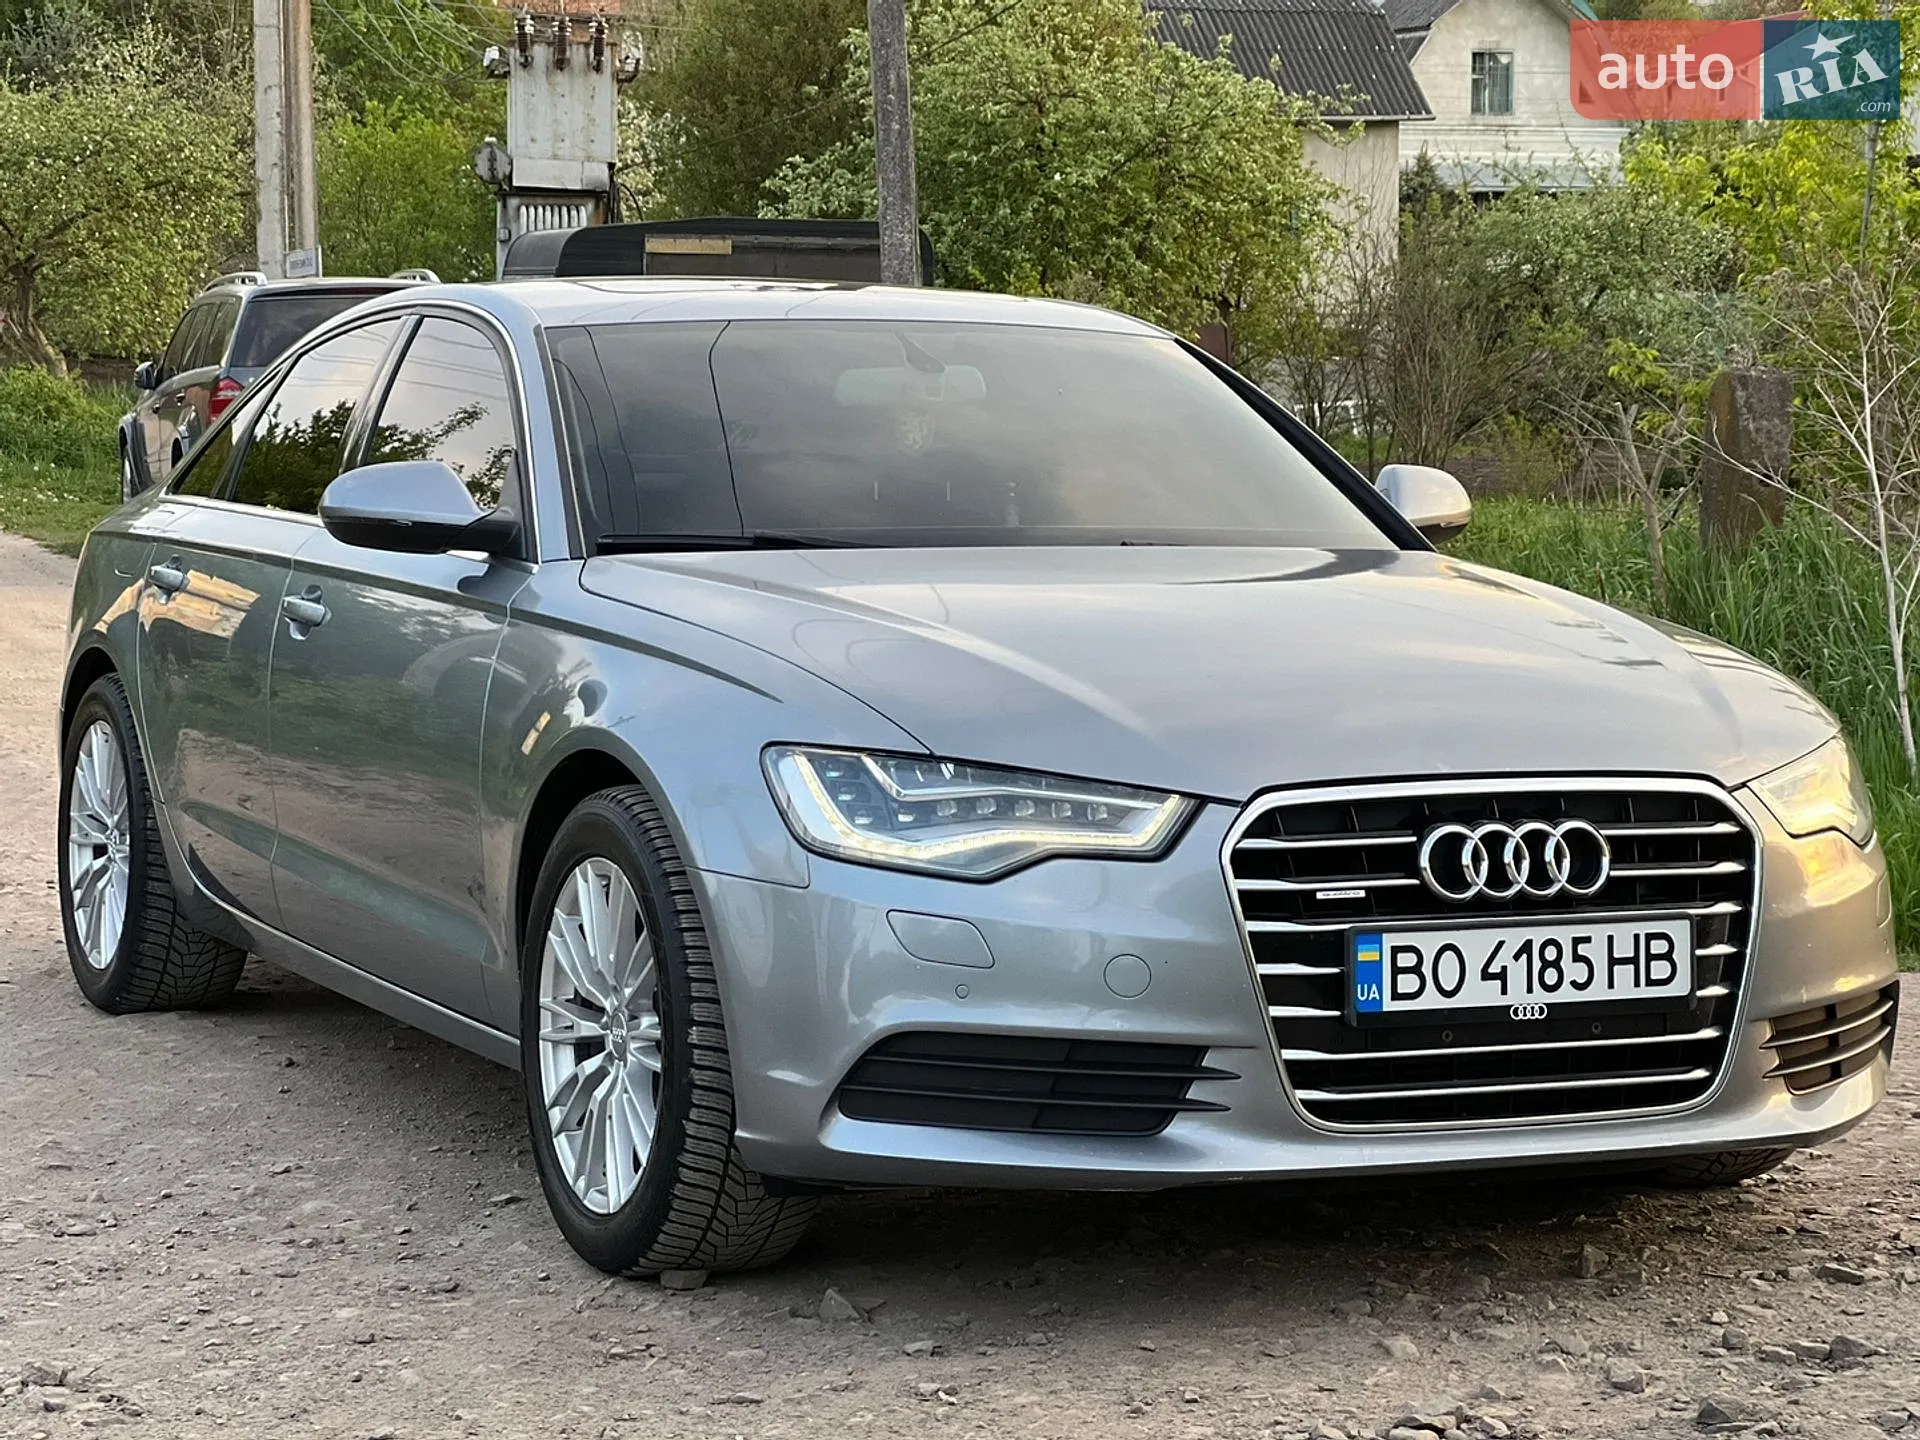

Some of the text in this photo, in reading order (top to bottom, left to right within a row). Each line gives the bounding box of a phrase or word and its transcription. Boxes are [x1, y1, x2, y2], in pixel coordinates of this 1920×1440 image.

[1390, 931, 1678, 1001] BO 4185 HB
[1357, 983, 1380, 1001] UA
